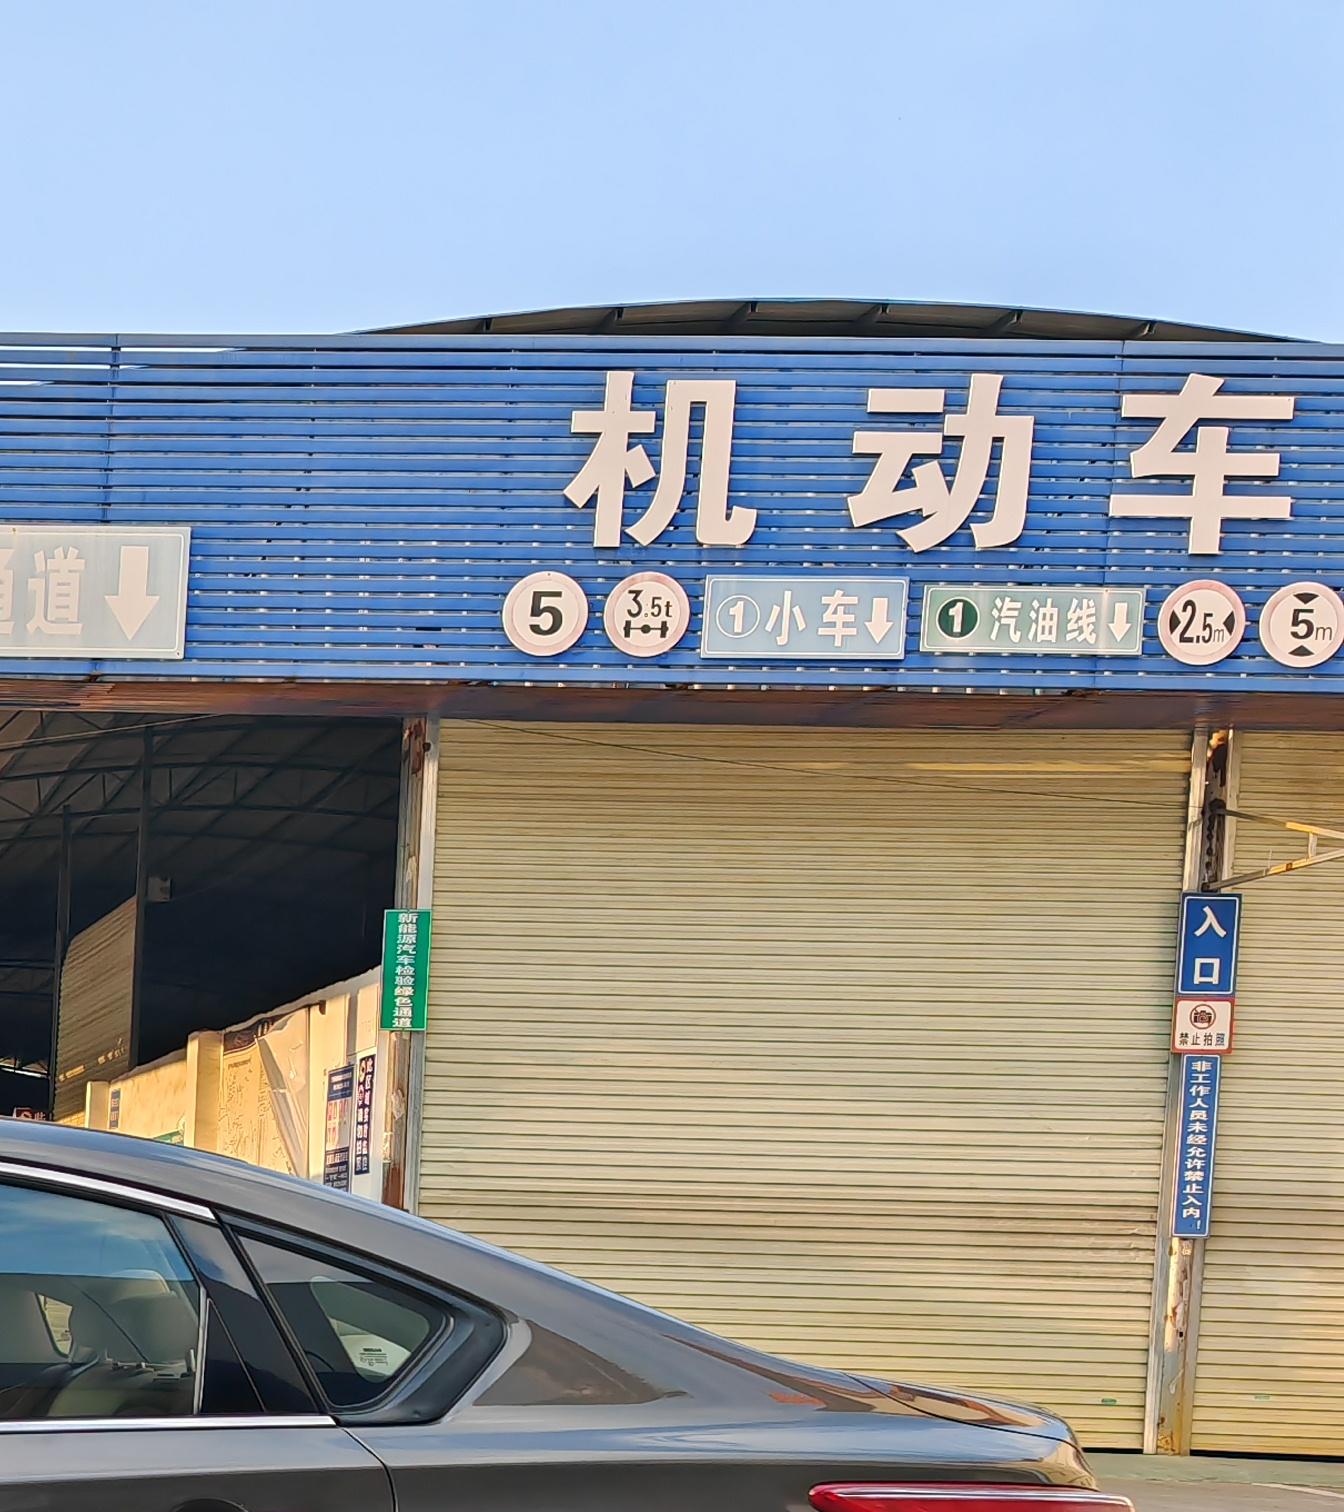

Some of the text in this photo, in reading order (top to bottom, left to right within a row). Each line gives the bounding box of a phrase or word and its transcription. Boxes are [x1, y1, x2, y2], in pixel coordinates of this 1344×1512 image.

[564, 370, 1296, 555] 机动车
[529, 590, 564, 636] 5
[627, 589, 673, 618] 3.5t
[1178, 599, 1226, 644] 2.5m
[1290, 608, 1333, 641] 5m
[1194, 907, 1227, 985] 入口
[392, 912, 418, 1028] 新能源汽车检验绿色通道
[1179, 1031, 1226, 1047] 禁止拍照
